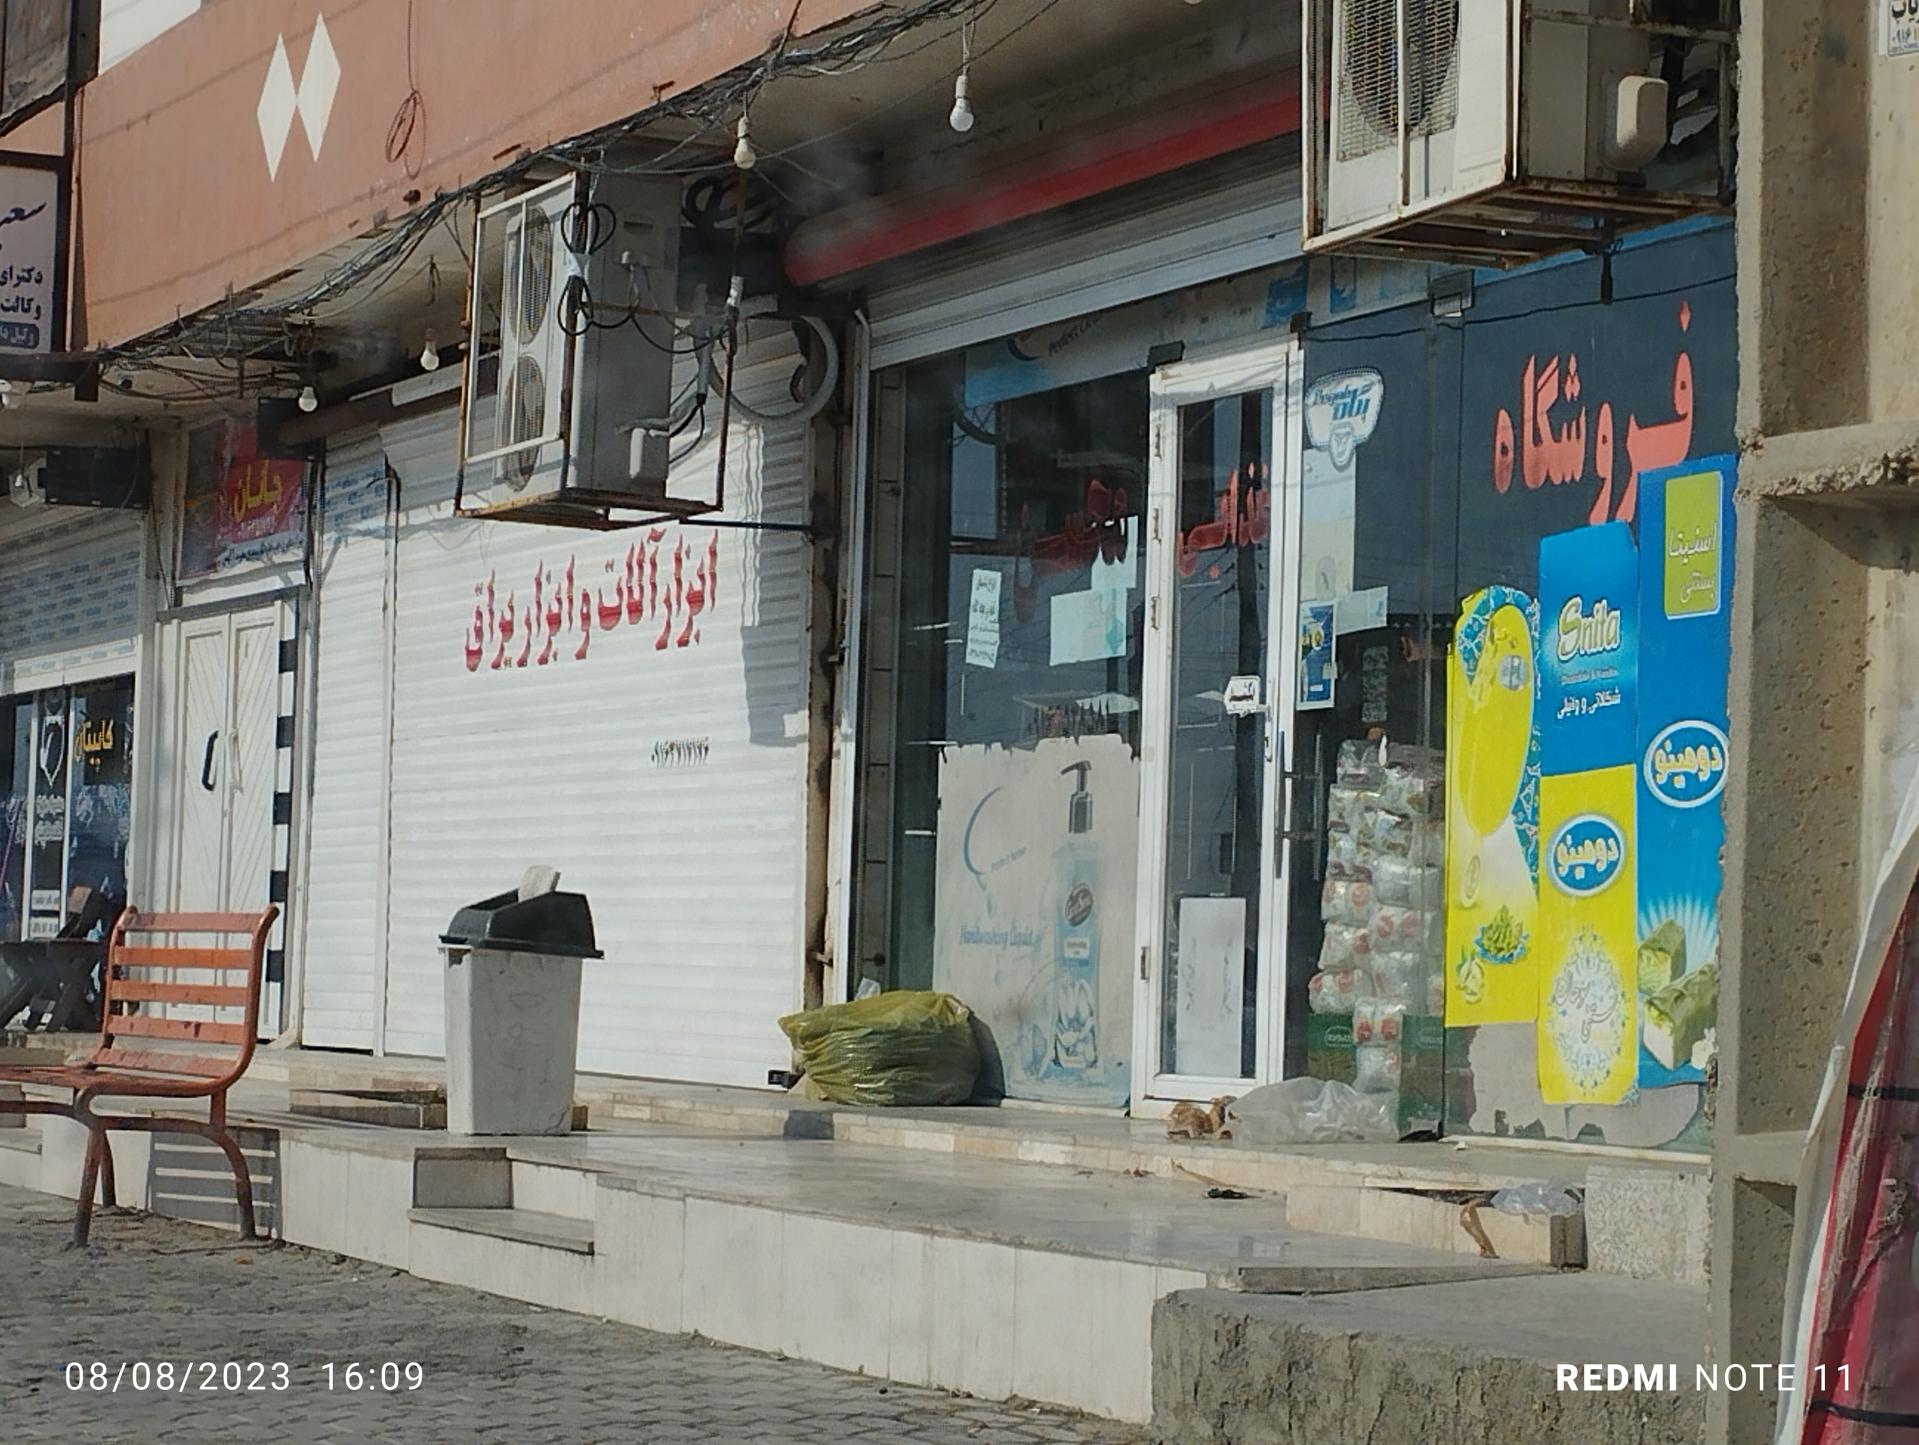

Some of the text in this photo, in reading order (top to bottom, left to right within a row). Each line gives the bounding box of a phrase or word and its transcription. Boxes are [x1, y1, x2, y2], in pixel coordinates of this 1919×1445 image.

[0, 296, 41, 320] وکالت
[1492, 300, 1695, 527] فروشگاه
[465, 568, 514, 673] یراق
[516, 553, 576, 667] ابزار
[574, 587, 592, 660] و
[1654, 739, 1723, 789] دومینو
[1555, 834, 1620, 880] دومینو
